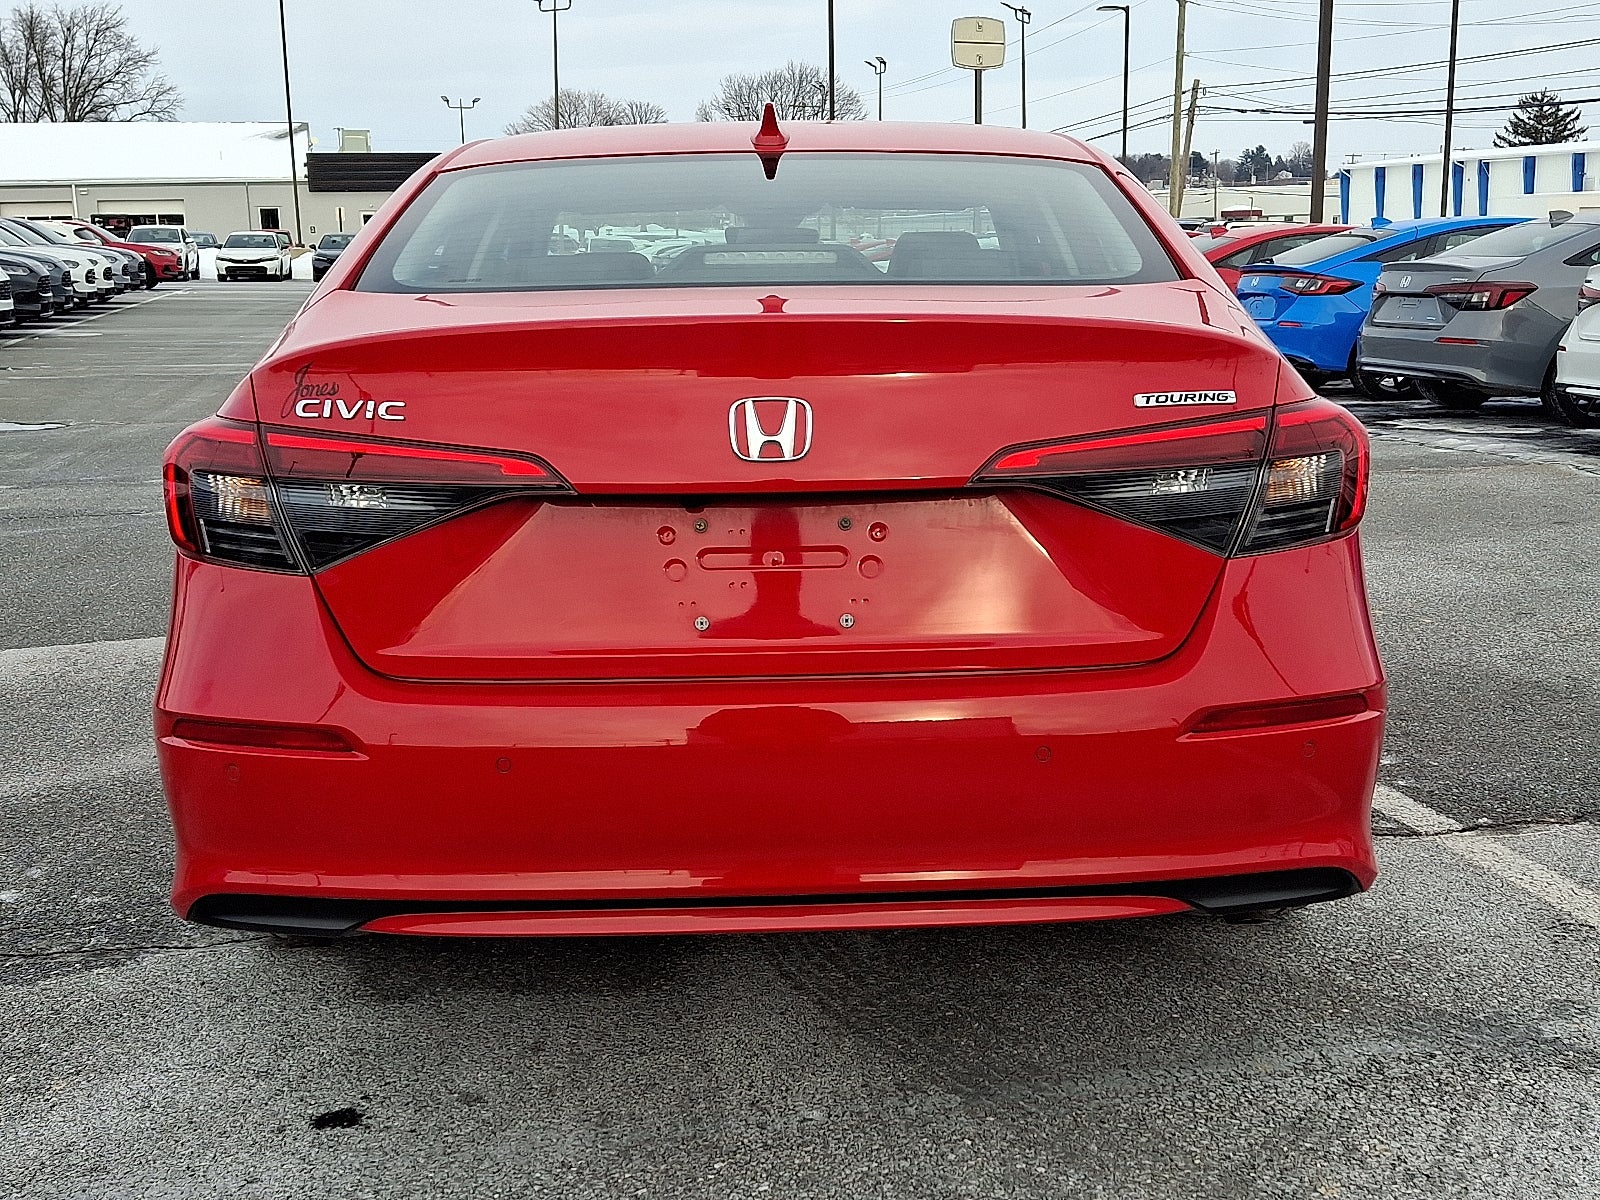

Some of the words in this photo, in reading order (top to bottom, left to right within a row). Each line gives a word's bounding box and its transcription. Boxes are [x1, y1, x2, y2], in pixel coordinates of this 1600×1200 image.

[281, 360, 339, 418] Jones
[1141, 392, 1229, 405] TOURING
[295, 398, 406, 420] CIVIC
